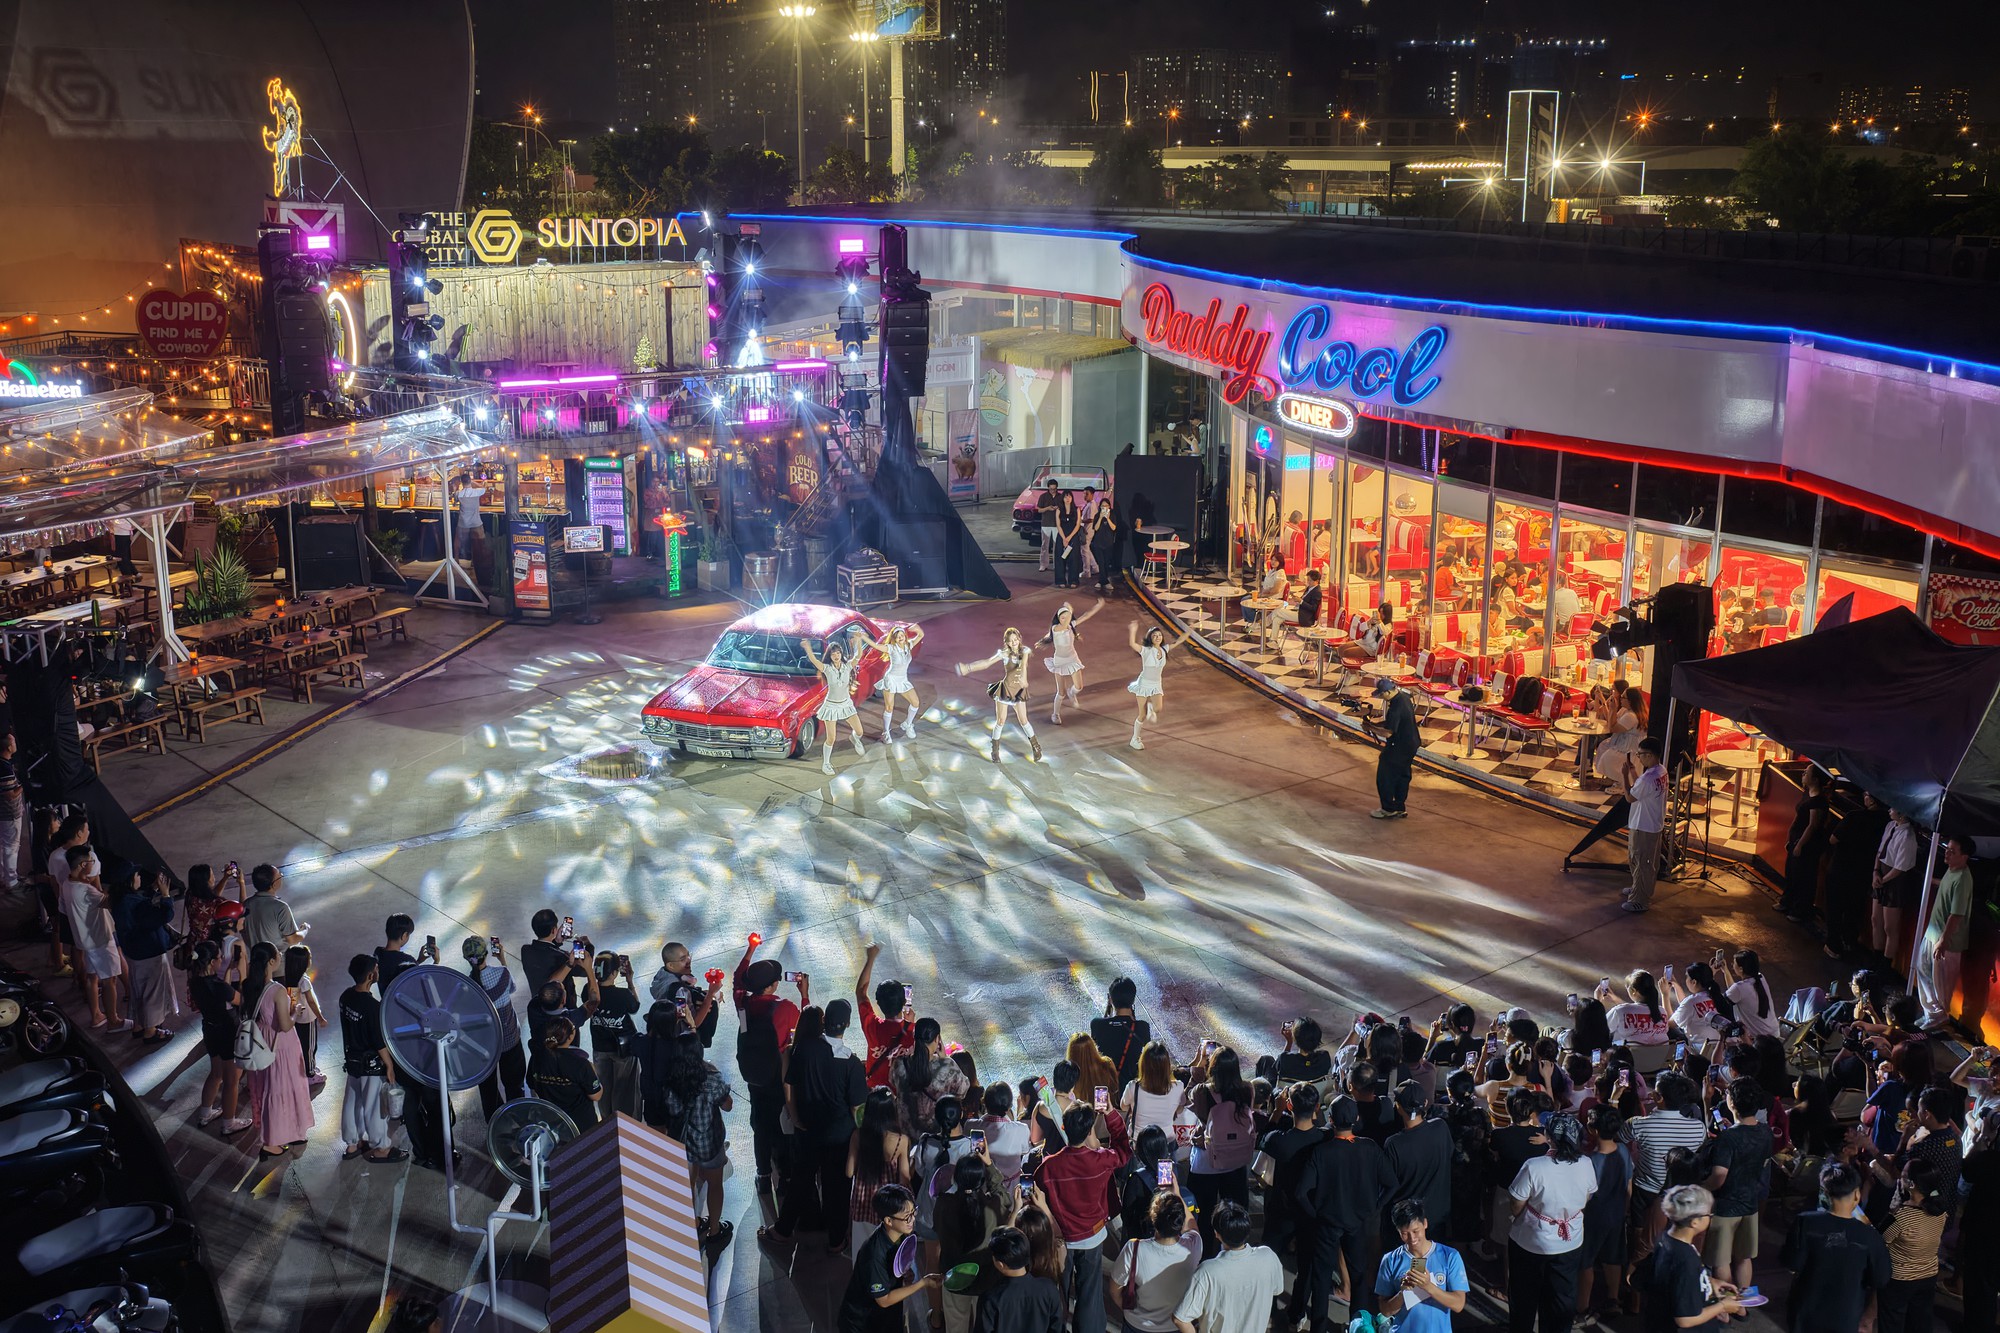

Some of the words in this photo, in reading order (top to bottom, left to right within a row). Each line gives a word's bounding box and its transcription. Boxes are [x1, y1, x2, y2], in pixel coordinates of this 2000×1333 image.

[538, 218, 687, 247] SUNTOPIA
[425, 247, 466, 262] CITY
[145, 301, 223, 324] CUPID,
[149, 327, 179, 338] FIND
[184, 328, 202, 338] ME
[208, 329, 217, 339] A
[157, 343, 209, 354] COWBOY
[1140, 282, 1276, 404] Daddy
[1278, 304, 1448, 406] Cool
[1291, 400, 1332, 429] DINER
[795, 454, 812, 468] COLD
[789, 465, 818, 488] BEER
[1961, 600, 2000, 619] Daddy
[1966, 613, 1996, 628] Cool
